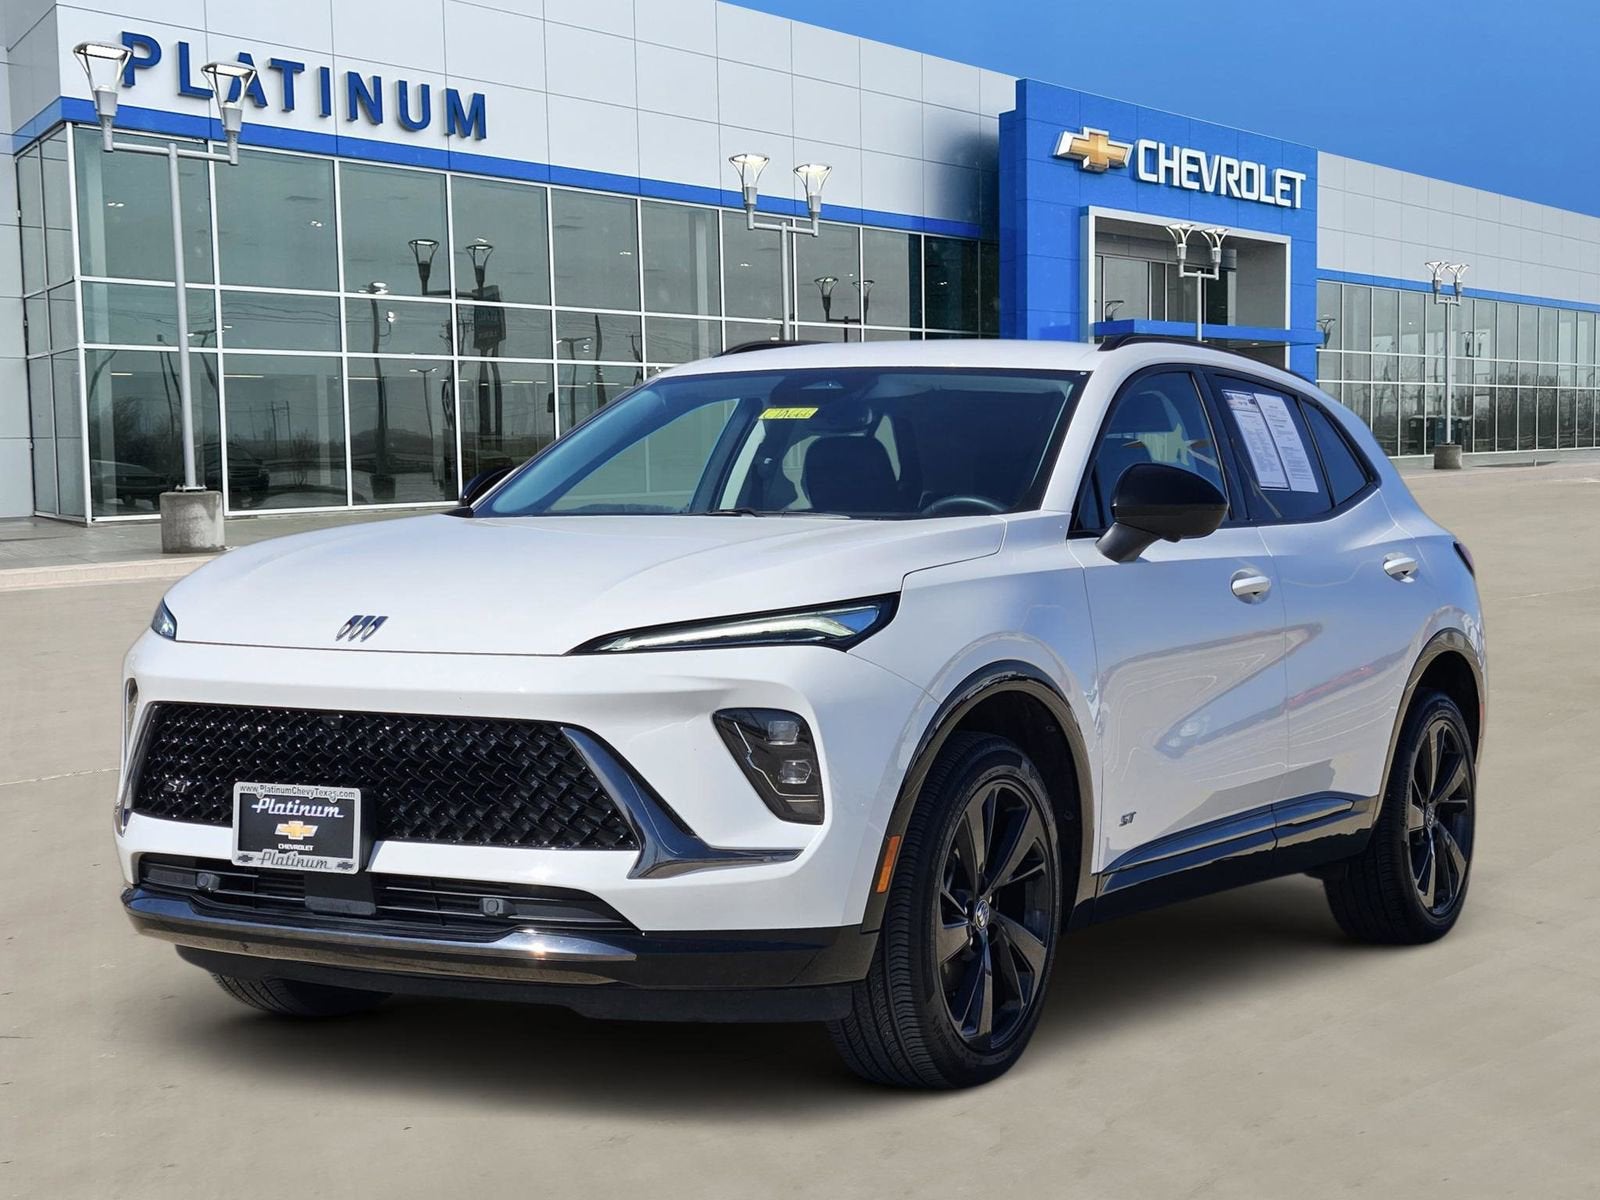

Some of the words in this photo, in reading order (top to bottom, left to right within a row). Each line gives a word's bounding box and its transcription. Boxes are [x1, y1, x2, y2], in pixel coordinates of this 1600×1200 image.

[121, 31, 487, 141] PLATINUM
[1137, 138, 1306, 209] CHEVROLET
[251, 797, 345, 818] Platinum
[257, 851, 332, 870] Platinum
